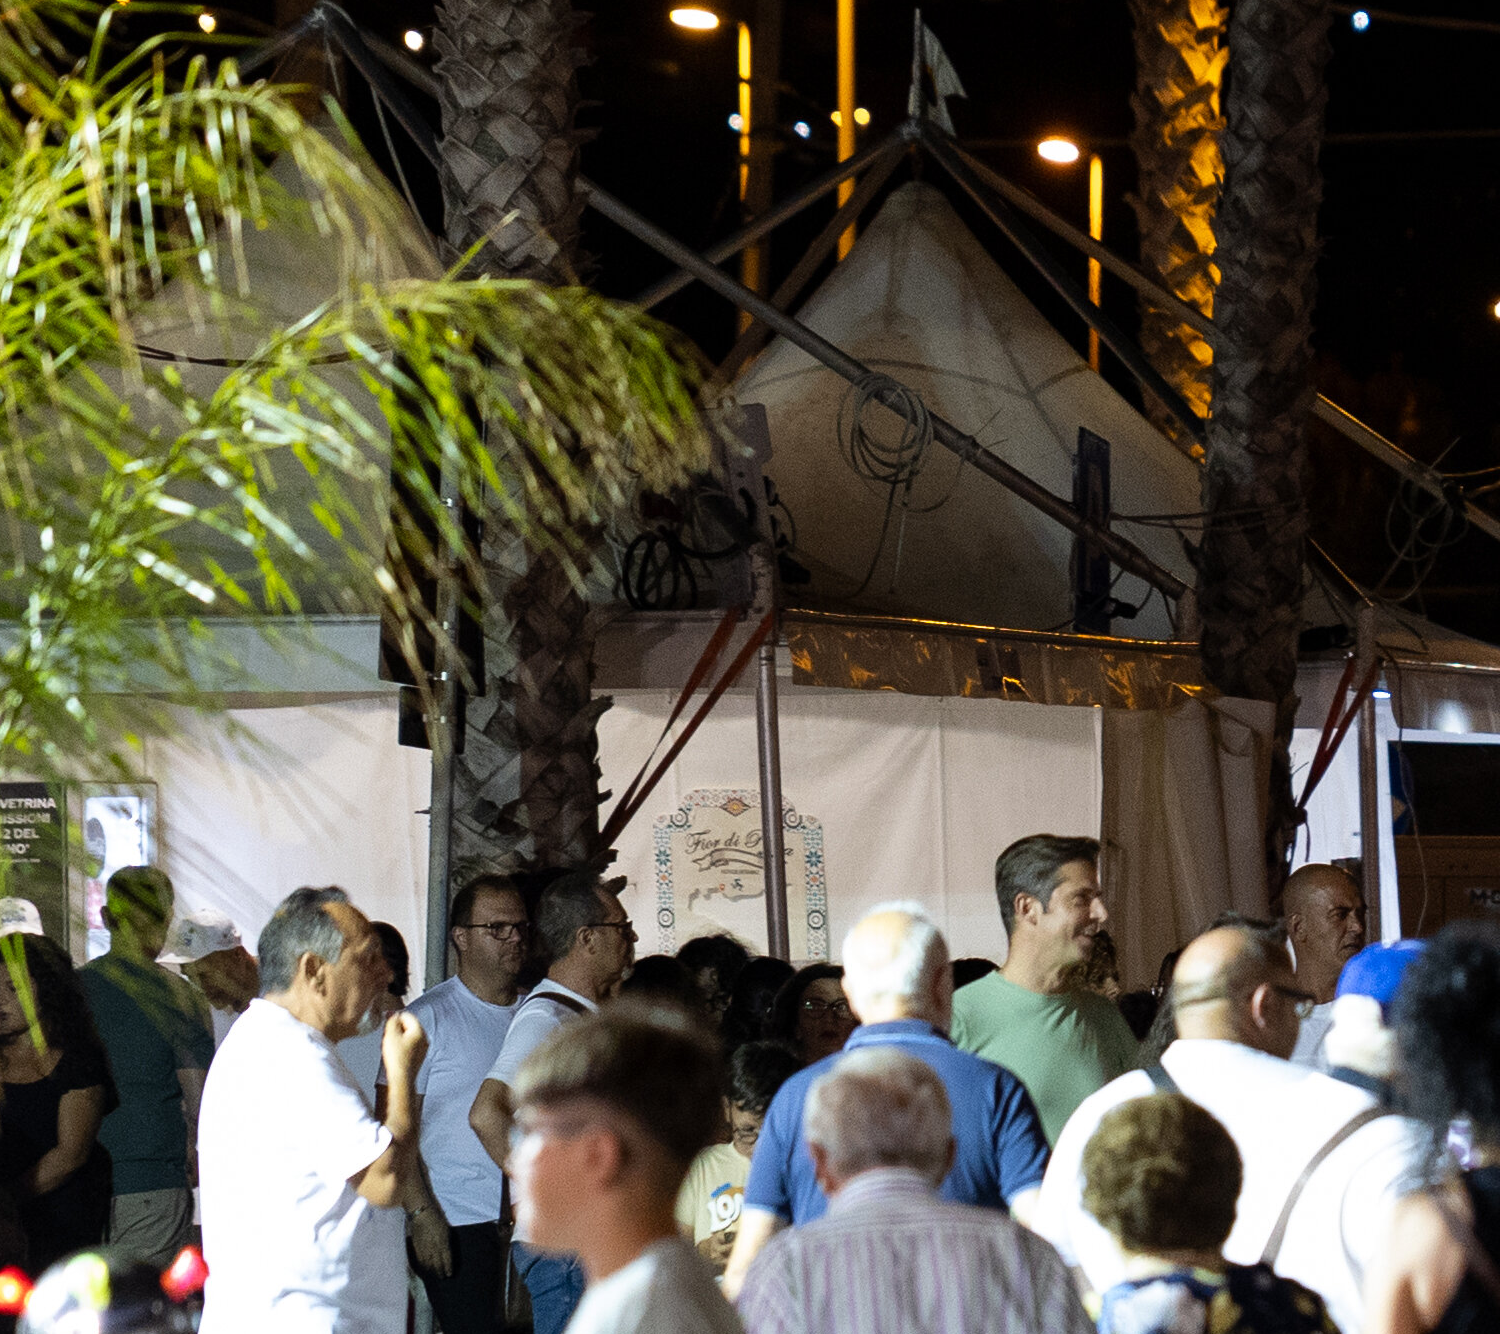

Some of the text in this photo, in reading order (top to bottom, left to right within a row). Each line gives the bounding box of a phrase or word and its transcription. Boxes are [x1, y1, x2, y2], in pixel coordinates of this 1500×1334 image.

[13, 827, 41, 839] DEL
[684, 829, 719, 854] Fior
[722, 831, 739, 848] di
